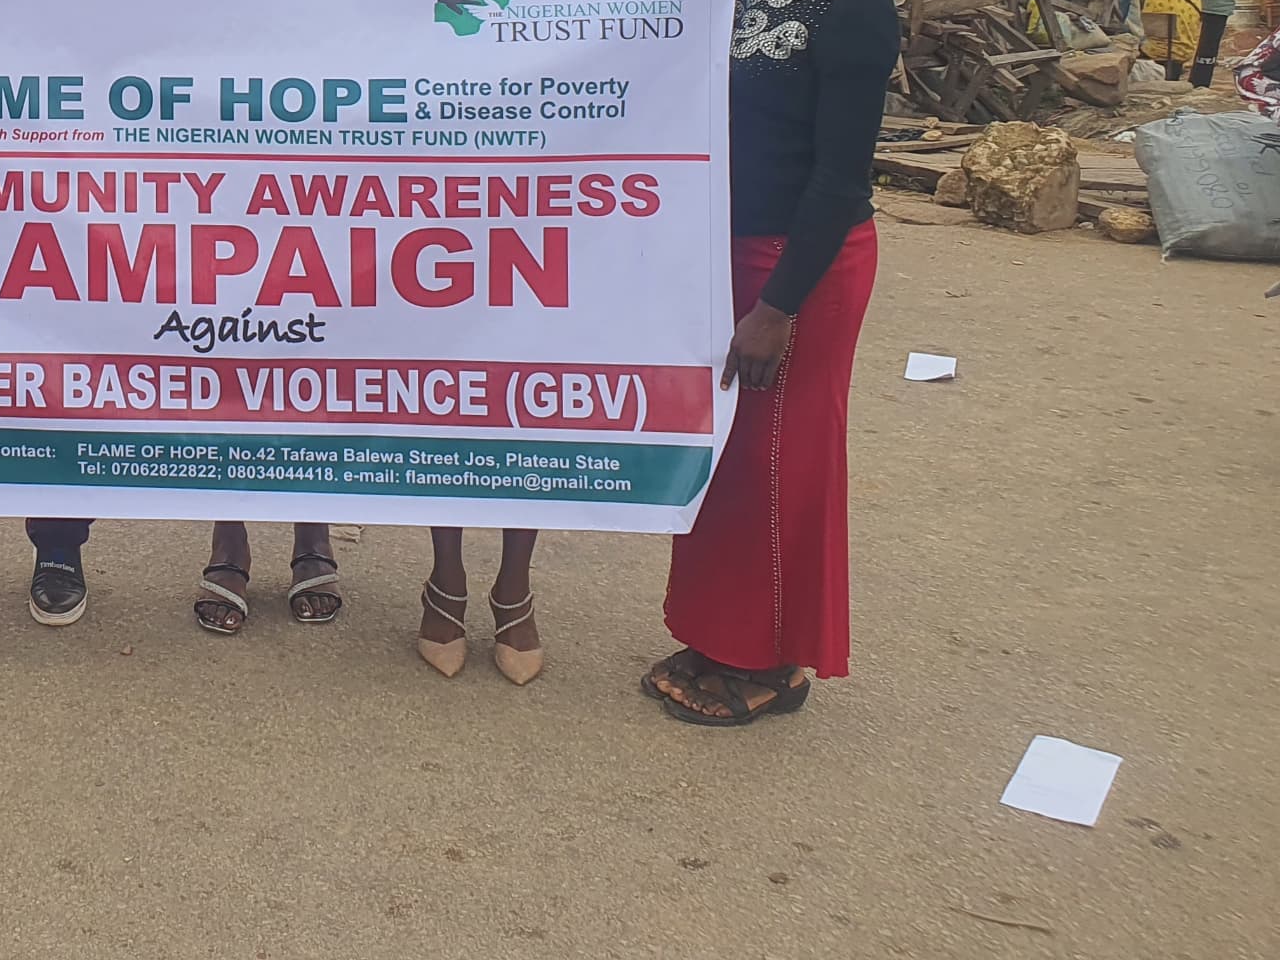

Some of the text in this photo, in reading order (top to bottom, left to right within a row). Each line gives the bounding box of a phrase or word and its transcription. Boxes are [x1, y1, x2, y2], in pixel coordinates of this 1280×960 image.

[507, 2, 601, 19] NIGERIAN
[606, 0, 684, 16] WOMEN
[490, 17, 684, 43] TRUST FUND
[108, 76, 194, 121] OF
[220, 77, 408, 123] HOPE
[414, 77, 630, 99] Centre for Poverty
[414, 100, 626, 120] & Disease Control
[12, 128, 69, 143] Support
[72, 128, 105, 141] from
[113, 127, 150, 142] THE
[157, 127, 249, 144] NIGERIAN
[255, 129, 332, 145] WOMEN
[339, 130, 406, 146] TRUST
[412, 130, 468, 146] FUND
[474, 131, 546, 150] (NWTF)
[246, 173, 661, 218] AWARENESS
[154, 307, 326, 353] Against
[63, 363, 220, 411] BASED
[236, 367, 489, 417] VIOLENCE
[506, 371, 648, 432] (GBV)
[77, 443, 620, 470] FLAME OF HOPE, No.42 Tafawa Balewa Street Jos, Plateau State
[77, 461, 107, 475] Tel:
[111, 462, 222, 480] 07062822822;
[343, 469, 400, 484] e-mail:
[405, 469, 631, 491] flameofhopen@gmail.com
